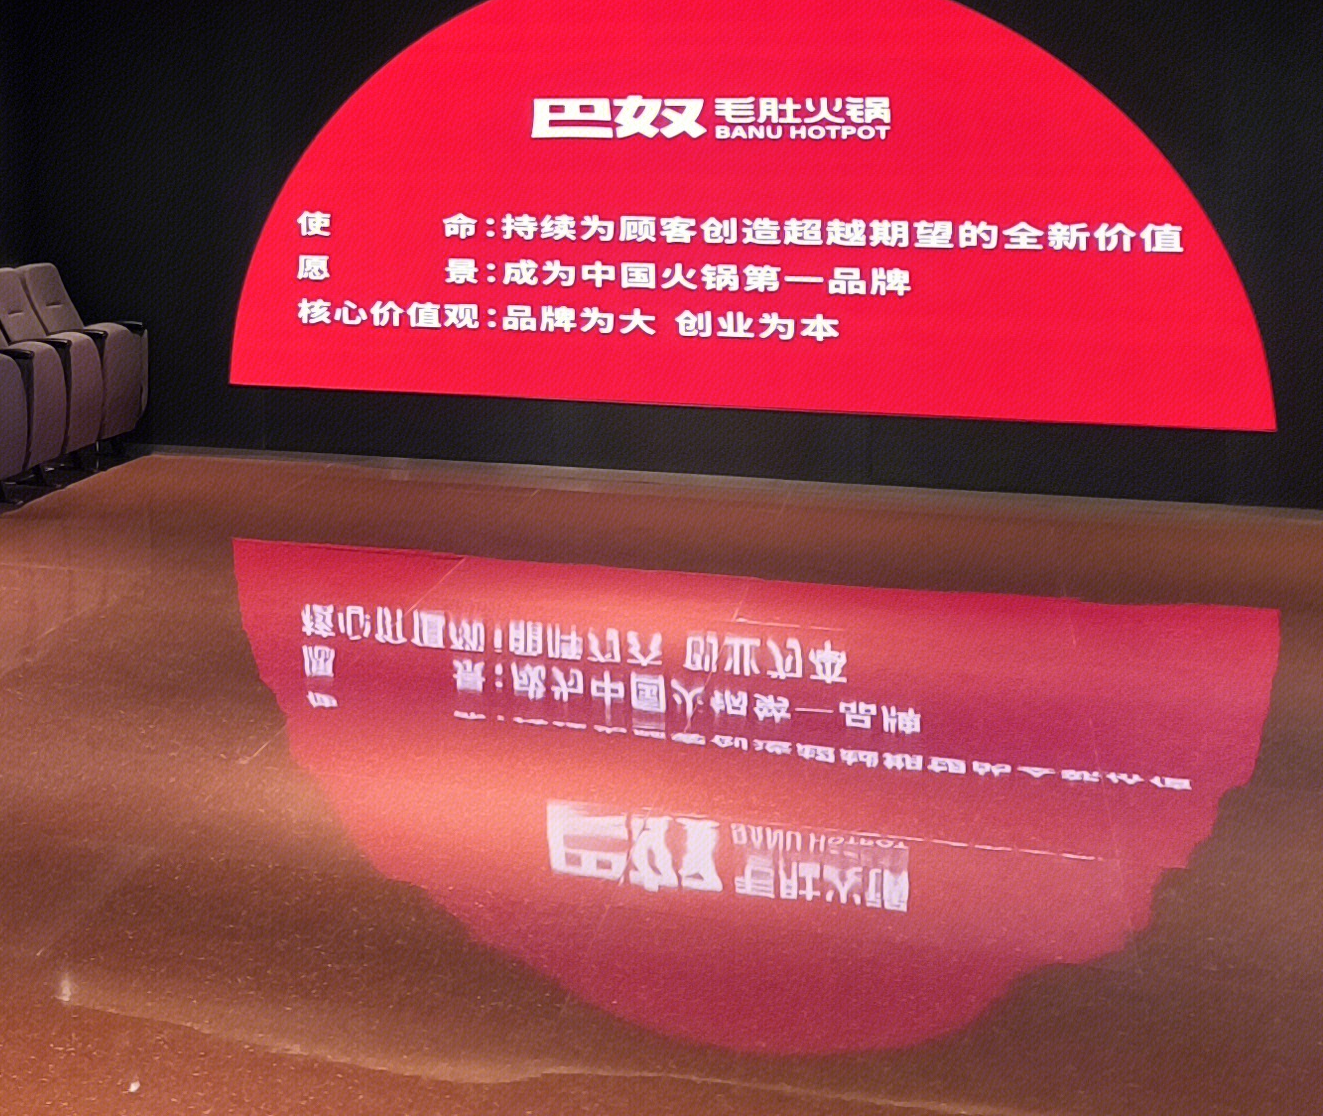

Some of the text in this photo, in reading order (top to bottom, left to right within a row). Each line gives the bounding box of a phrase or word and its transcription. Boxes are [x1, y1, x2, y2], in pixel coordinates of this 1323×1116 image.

[530, 94, 892, 139] 巴奴 毛肚火锅
[714, 125, 892, 141] BANU HOTPOT
[674, 309, 840, 342] 创业为本
